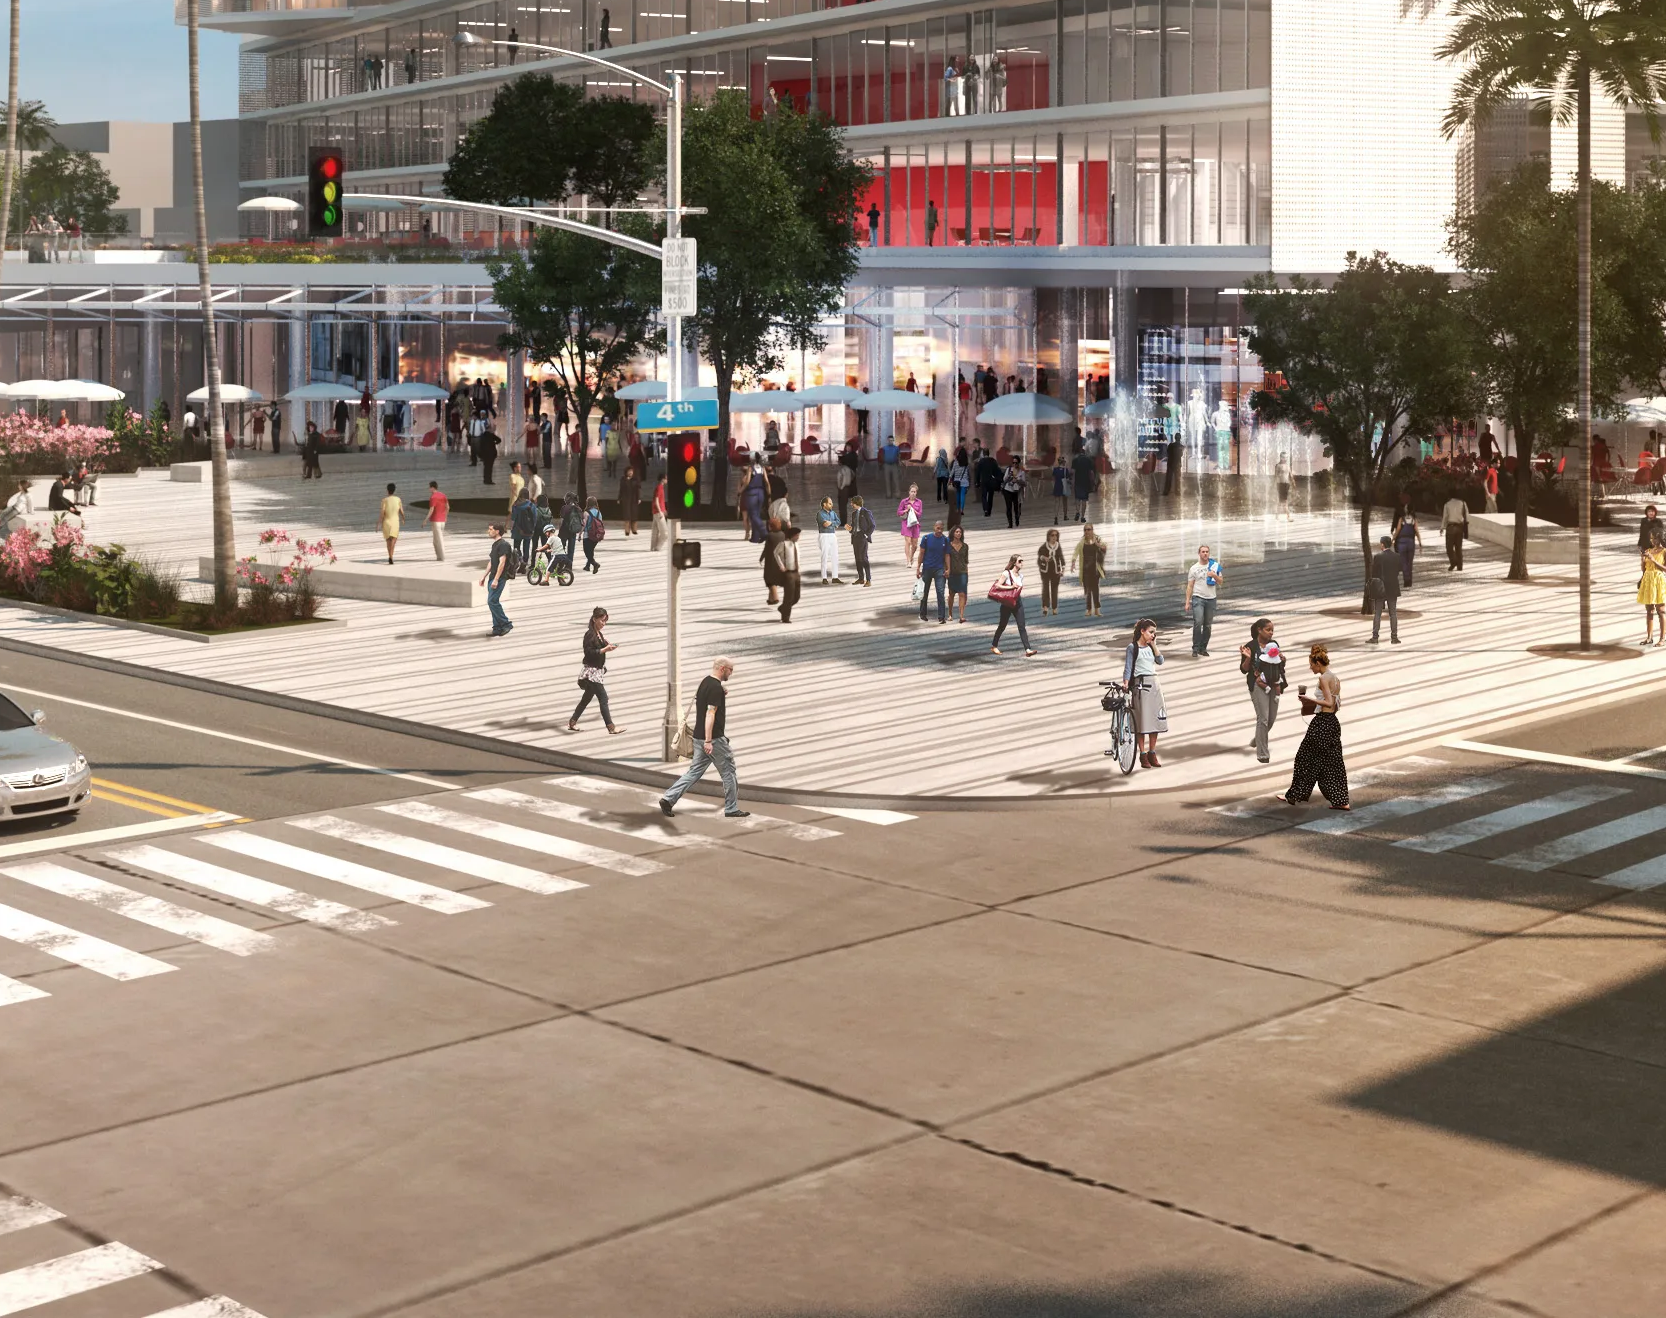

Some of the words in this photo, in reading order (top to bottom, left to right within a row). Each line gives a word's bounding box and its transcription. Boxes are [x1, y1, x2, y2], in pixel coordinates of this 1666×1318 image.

[667, 243, 675, 253] DO
[678, 242, 688, 253] NOT
[666, 255, 689, 267] BLOCK
[668, 297, 687, 309] $500
[656, 402, 693, 421] 4th
